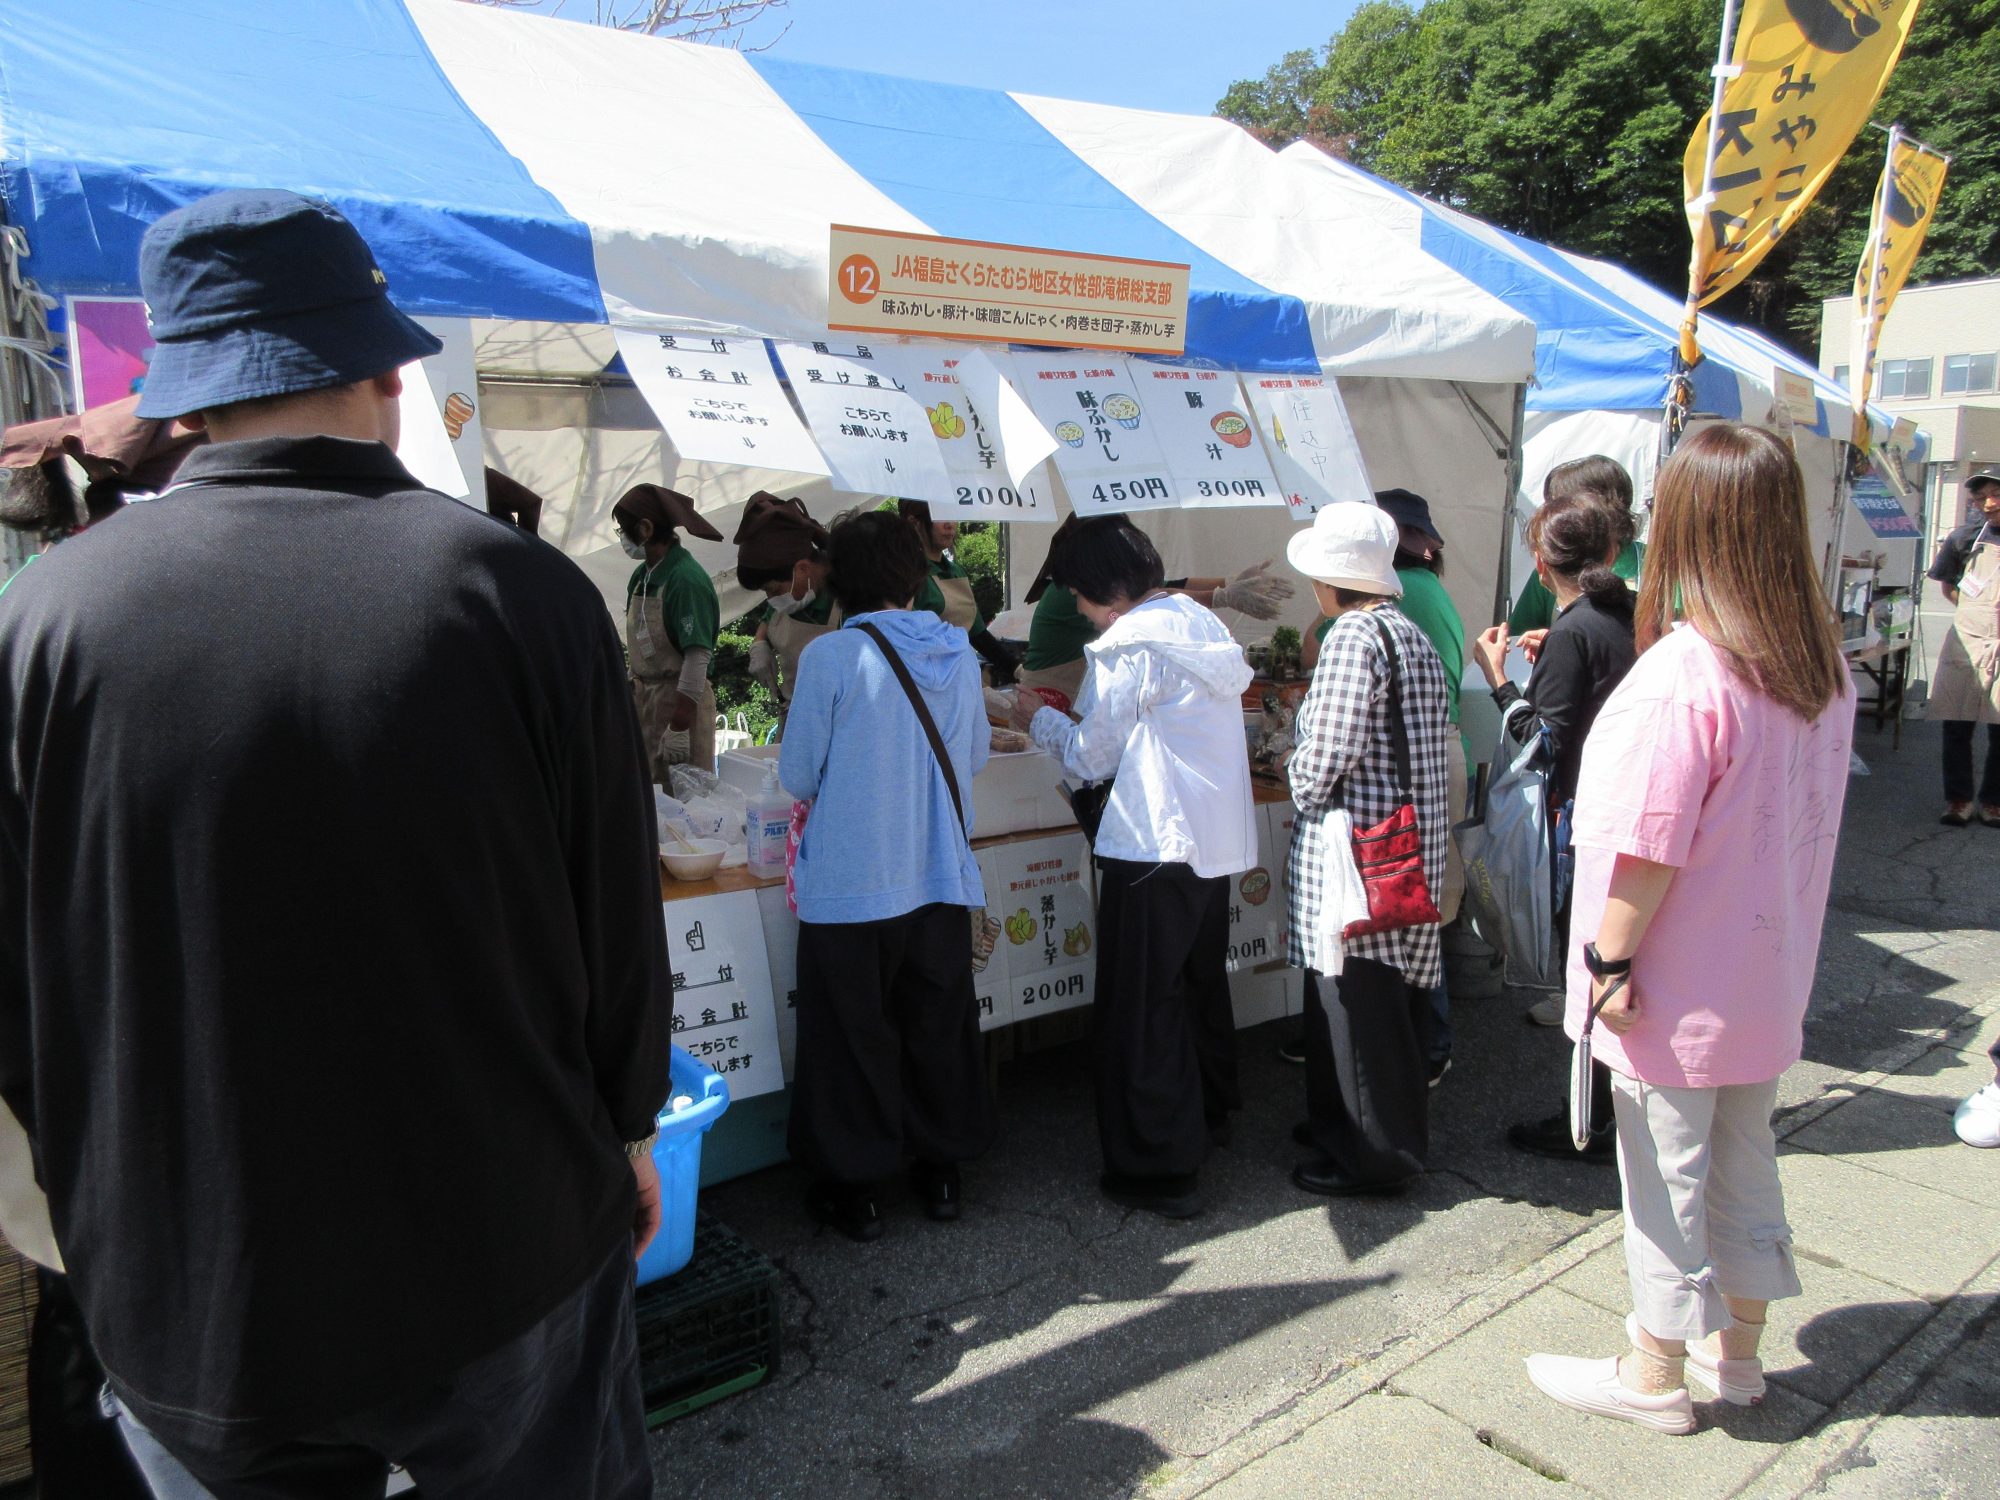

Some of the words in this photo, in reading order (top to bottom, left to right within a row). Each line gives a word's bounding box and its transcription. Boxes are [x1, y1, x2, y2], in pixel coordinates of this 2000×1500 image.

[845, 265, 876, 295] 12
[891, 253, 1172, 306] JA福島さくらたむら地区女性部滝根総支部
[659, 335, 727, 353] 受付
[666, 365, 749, 385] お会計
[806, 369, 907, 391] 受け渡し
[693, 398, 749, 411] こちらで
[844, 406, 893, 423] こちらで
[687, 409, 769, 426] お願いします
[1075, 389, 1120, 462] 味ふかし
[1184, 390, 1224, 462] 豚汁
[839, 423, 909, 443] お願いします
[1091, 477, 1169, 503] 450円
[1197, 479, 1266, 498] 300円
[1040, 894, 1059, 967] 蒸かし芋
[1228, 937, 1267, 961] 00円
[671, 963, 734, 988] 受付
[1023, 973, 1085, 1005] 200円
[671, 1001, 748, 1031] お会計
[977, 995, 994, 1016] 円
[688, 1035, 739, 1058] こちらで
